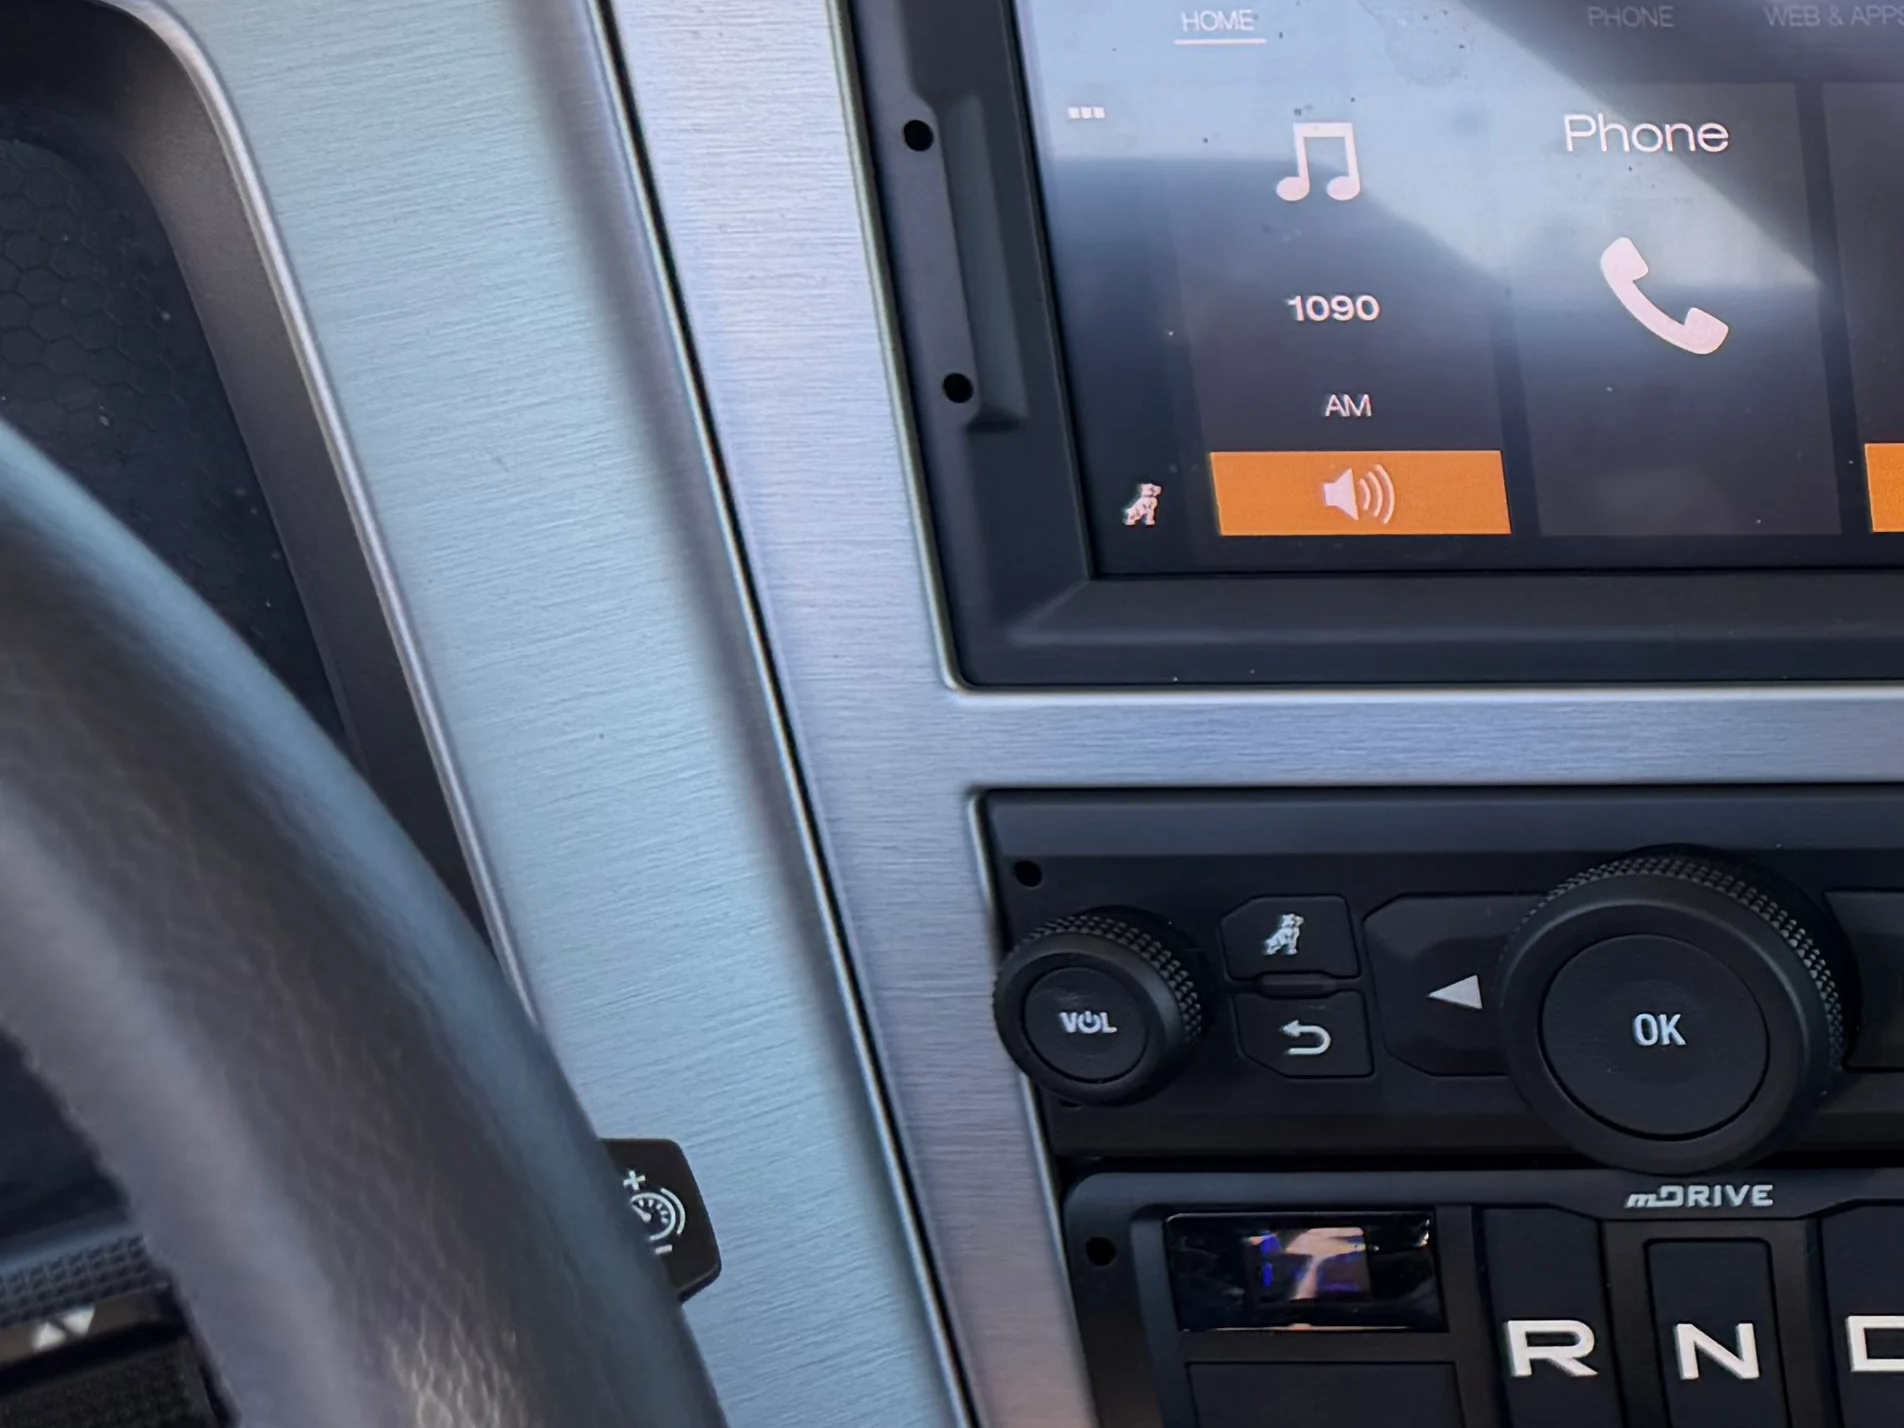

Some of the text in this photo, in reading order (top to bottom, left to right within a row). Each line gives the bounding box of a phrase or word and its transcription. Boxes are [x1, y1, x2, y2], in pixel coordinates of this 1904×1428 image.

[1180, 10, 1256, 32] HOME
[1588, 5, 1675, 29] PHONE
[1764, 4, 1822, 28] WEB
[1828, 4, 1845, 28] &
[1563, 112, 1730, 154] Phone
[1287, 295, 1381, 322] 1090
[1325, 394, 1372, 417] AM
[1060, 1011, 1117, 1034] VOL
[1633, 1013, 1686, 1046] OK
[1624, 1184, 1773, 1208] mDRIVE
[1504, 1319, 1598, 1377] R
[1675, 1322, 1760, 1380] N
